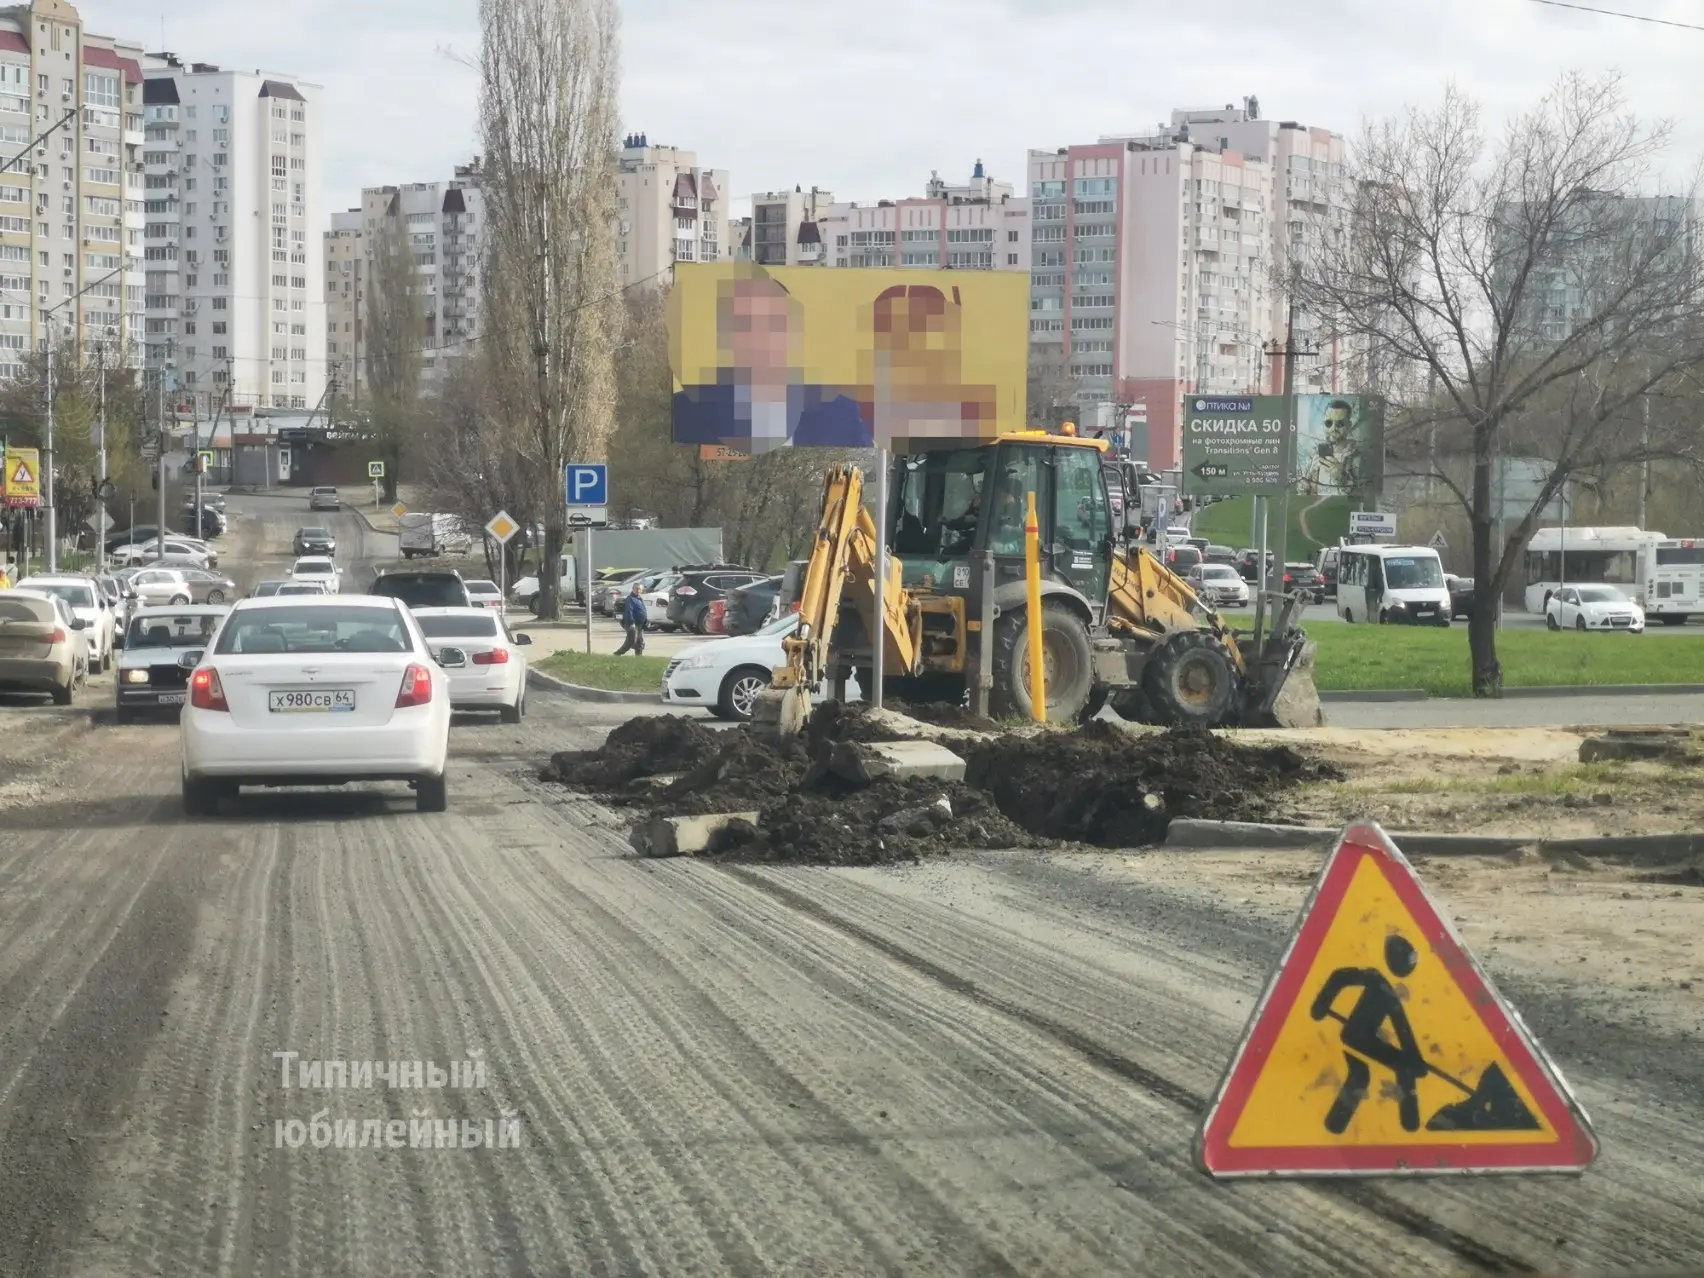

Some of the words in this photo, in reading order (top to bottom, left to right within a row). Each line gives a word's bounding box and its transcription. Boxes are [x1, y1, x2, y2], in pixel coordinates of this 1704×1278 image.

[1191, 418, 1258, 434] СКИДКА
[1204, 437, 1262, 445] фотохромные
[1253, 446, 1271, 454] Gen
[575, 469, 598, 500] P
[335, 691, 349, 702] 64
